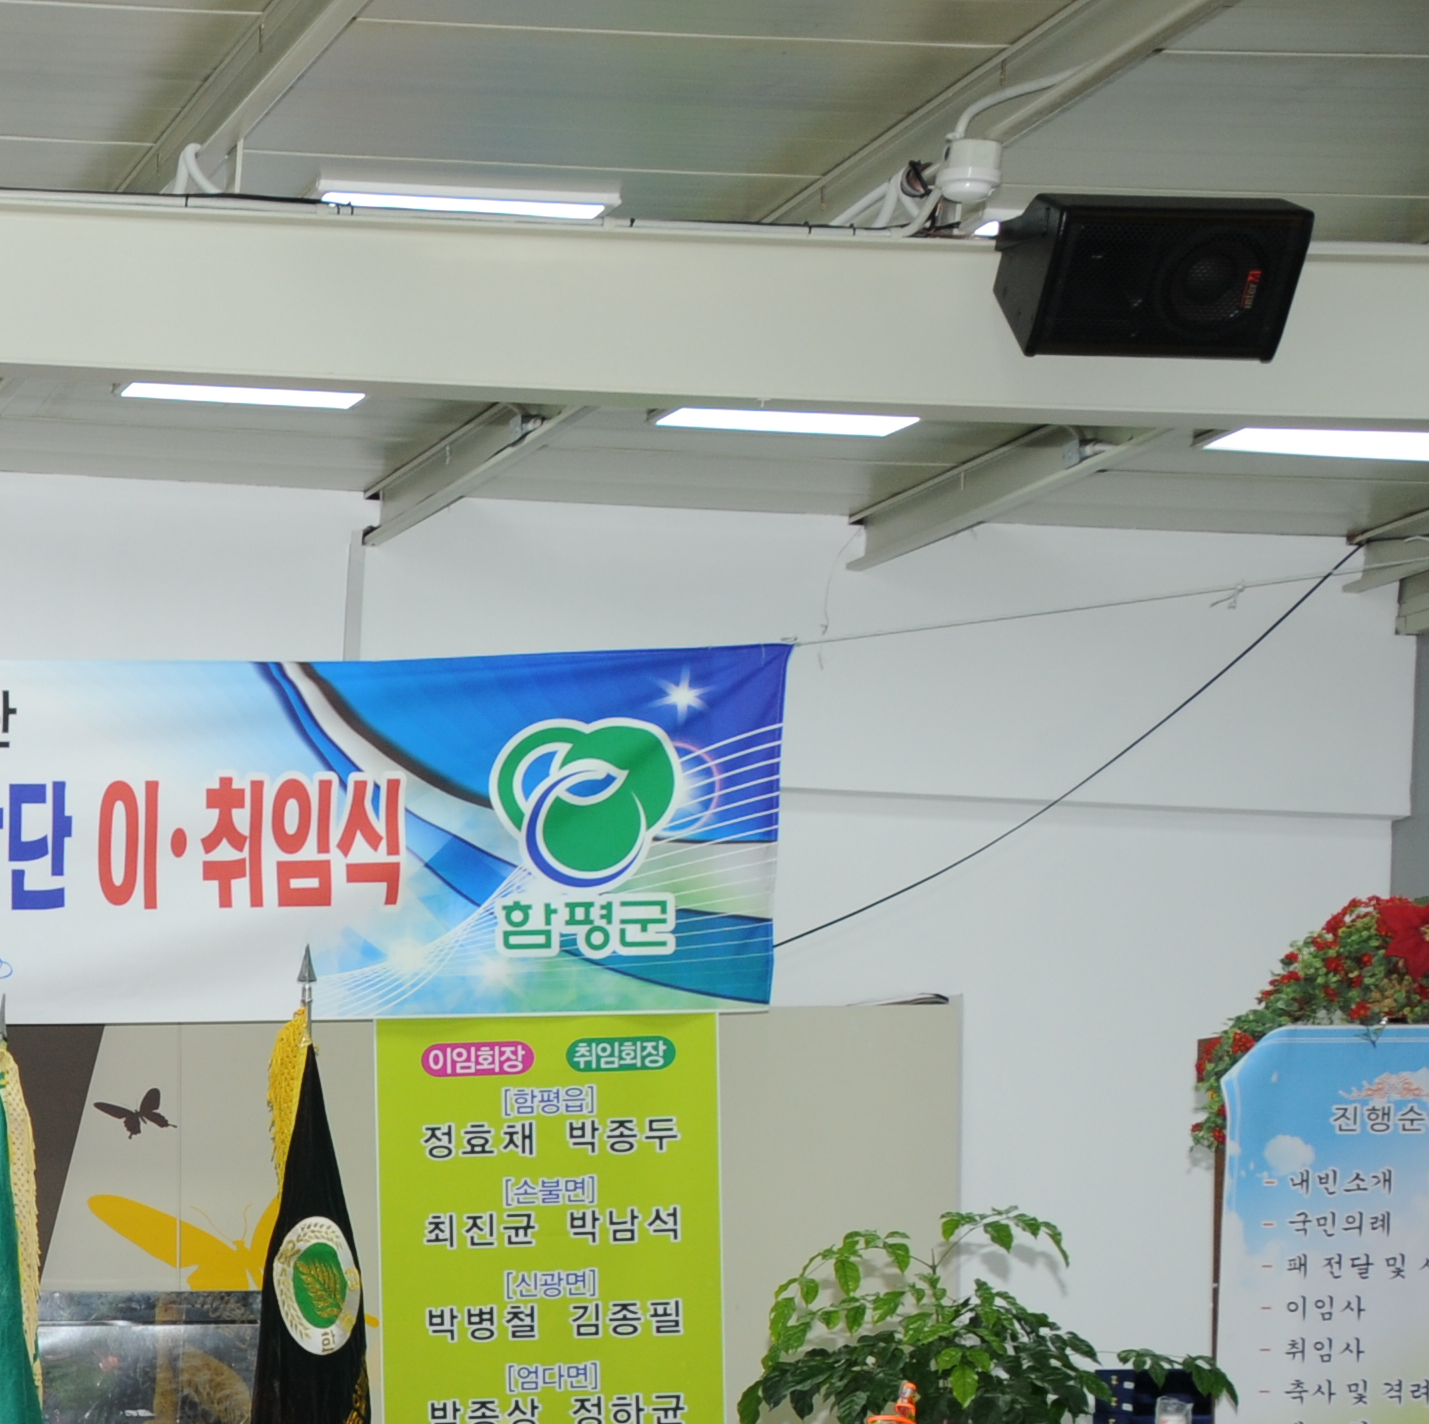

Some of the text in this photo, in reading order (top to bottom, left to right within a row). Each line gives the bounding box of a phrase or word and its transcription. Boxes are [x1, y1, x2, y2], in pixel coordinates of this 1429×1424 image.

[97, 775, 405, 910] 이·취임식
[502, 896, 672, 950] 함평군
[428, 1038, 667, 1074] 이임회장 취임회장
[1332, 1104, 1426, 1133] 진행순
[422, 1117, 680, 1159] 정효채 박종두
[1289, 1168, 1393, 1195] 내빈소개
[424, 1206, 682, 1249] 최진균 박남석
[1288, 1210, 1392, 1238] 국민의례
[1286, 1253, 1308, 1279] 패
[1322, 1253, 1375, 1280] 전달
[1384, 1253, 1407, 1280] 및
[427, 1300, 684, 1343] 박병철 김종필
[1286, 1295, 1367, 1322] 이임사
[1284, 1337, 1366, 1364] 취임사
[1284, 1379, 1337, 1405] 축사
[1346, 1379, 1368, 1405] 및
